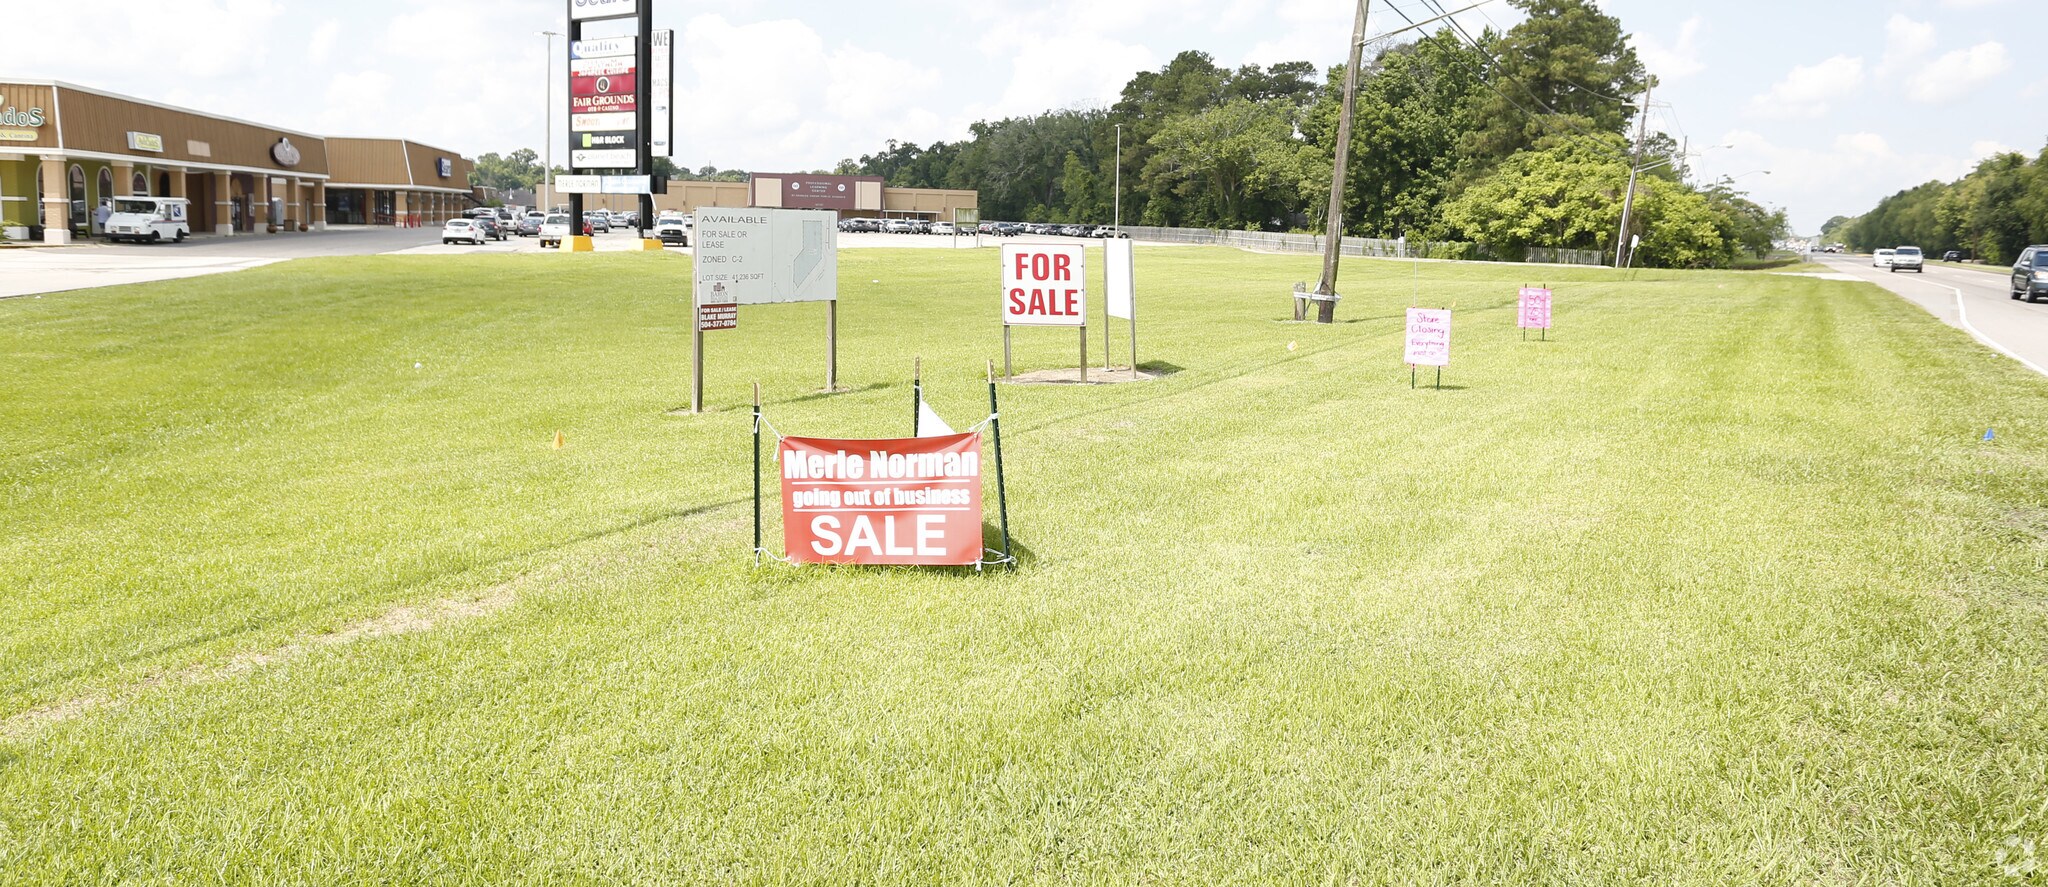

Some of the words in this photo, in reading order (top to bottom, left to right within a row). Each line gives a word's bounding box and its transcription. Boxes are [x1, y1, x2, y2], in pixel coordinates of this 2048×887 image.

[653, 31, 668, 46] WE
[573, 97, 592, 107] FAIR
[592, 94, 635, 106] GROUNDS
[604, 135, 625, 144] BLOCK
[702, 215, 767, 224] AVAILABLE
[702, 230, 717, 238] FOR
[718, 230, 736, 238] SALE
[737, 230, 748, 238] OR
[702, 241, 724, 249] LEASE
[702, 255, 727, 263] ZONED
[731, 255, 743, 263] C-2
[1015, 253, 1071, 281] FOR
[702, 274, 715, 282] LOT
[1009, 287, 1079, 316] SALE
[1416, 312, 1440, 324] Store
[1411, 324, 1445, 339] Closing
[1411, 339, 1445, 350] Everything
[784, 449, 864, 479] Merle
[870, 449, 979, 478] Norman
[792, 487, 841, 508] going
[843, 488, 871, 506] out
[873, 487, 891, 506] of
[893, 486, 970, 505] business
[810, 514, 947, 556] SALE
